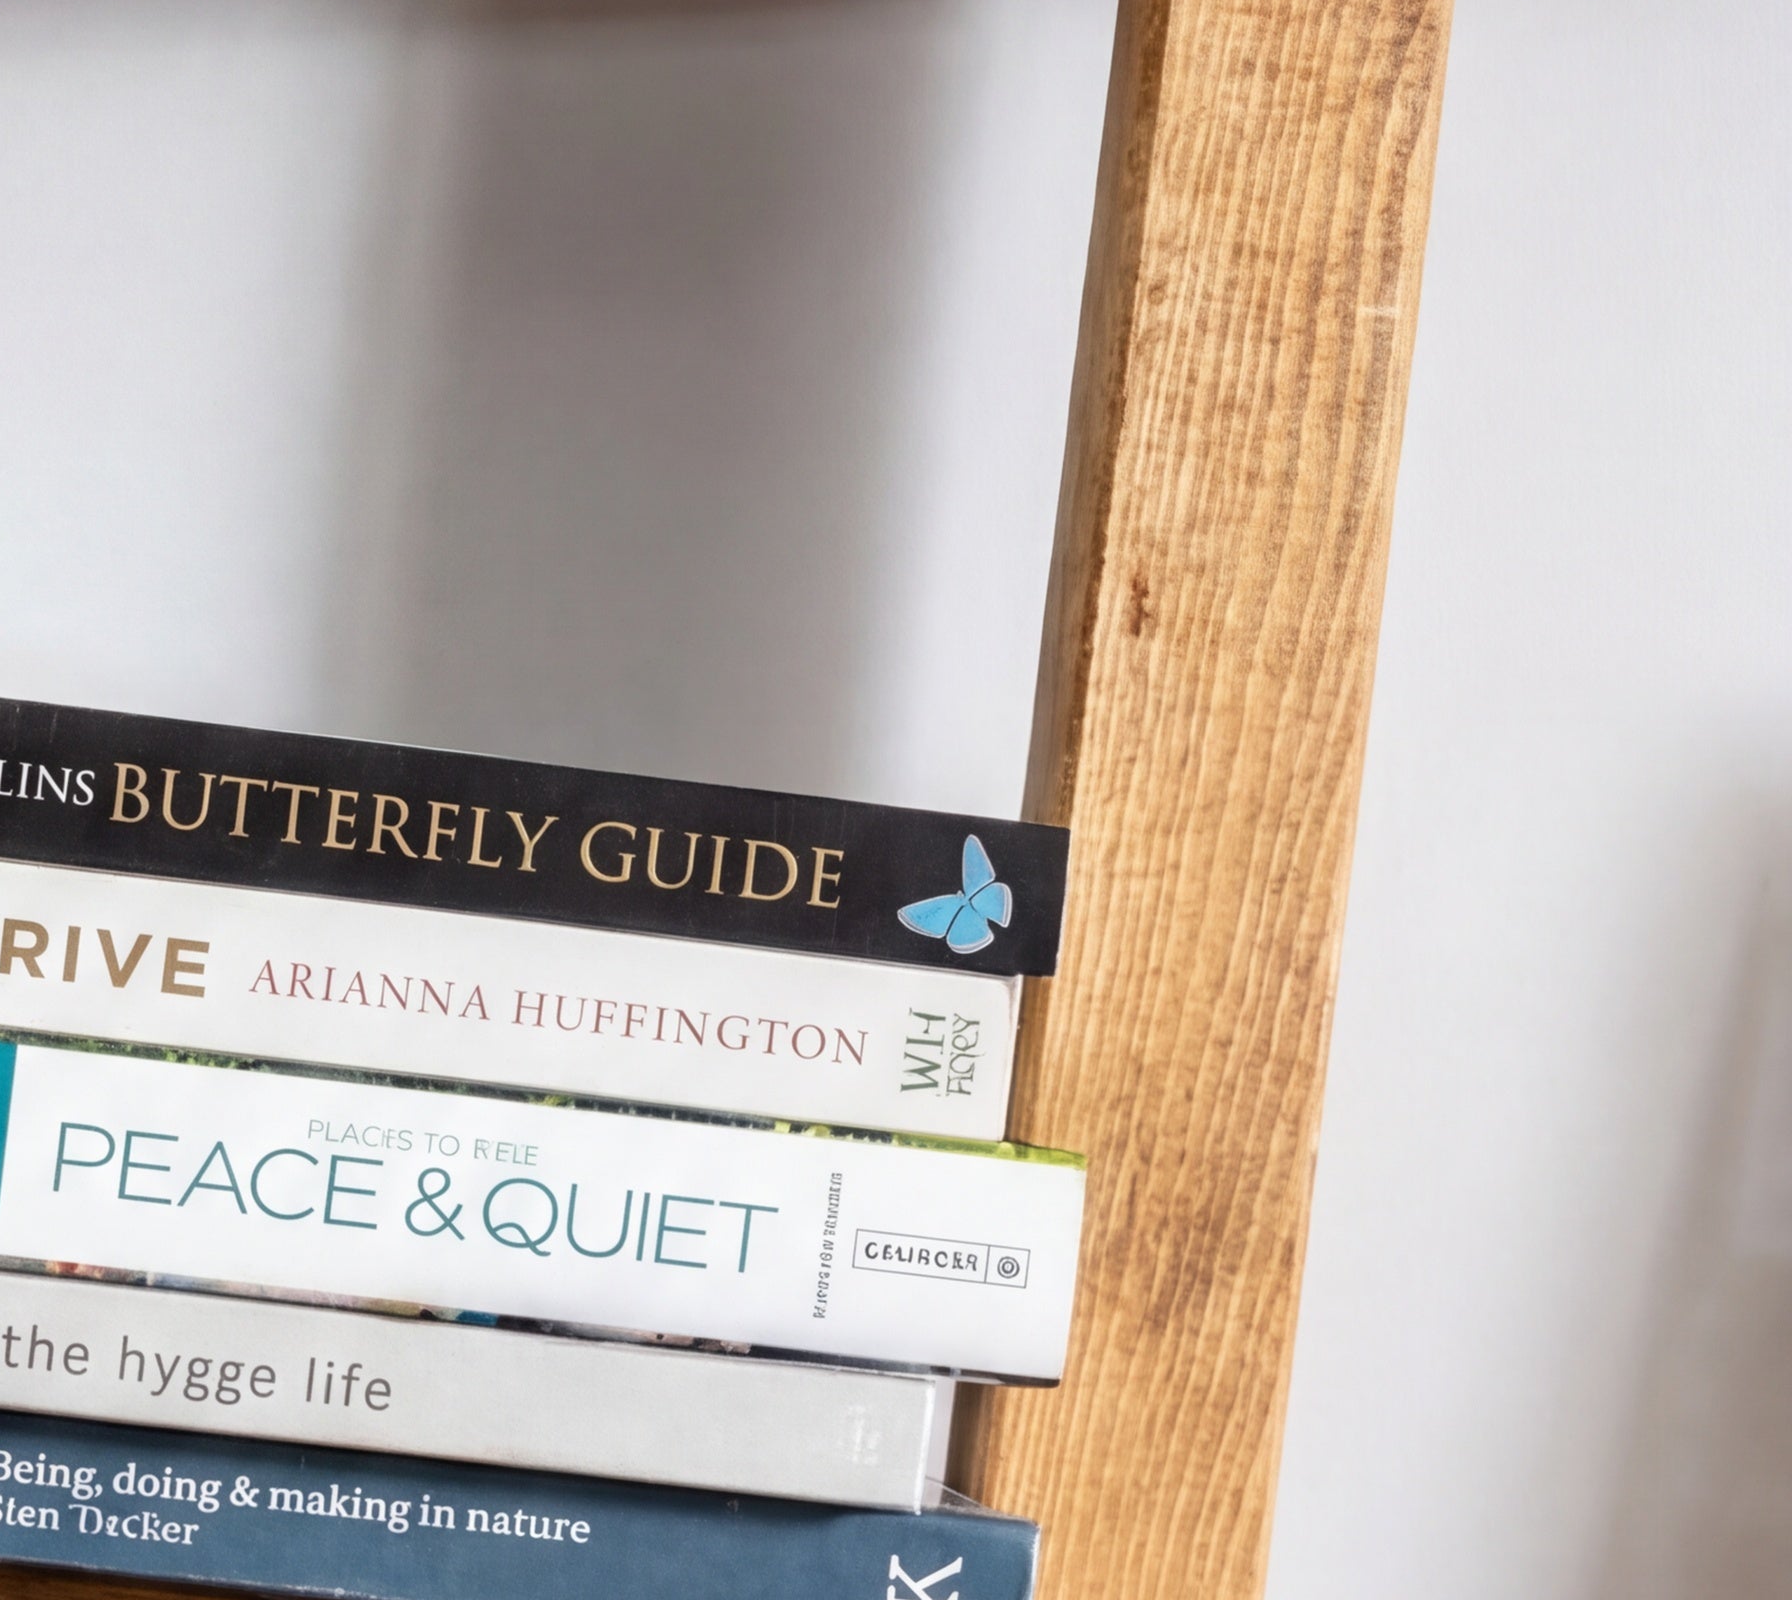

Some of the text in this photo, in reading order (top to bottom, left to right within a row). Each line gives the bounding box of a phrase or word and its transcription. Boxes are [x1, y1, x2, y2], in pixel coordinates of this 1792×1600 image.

[109, 761, 559, 873] BUTTERFLY
[580, 820, 845, 910] GUIDE
[248, 959, 490, 1021] ARIANNA
[512, 990, 870, 1066] HUFFINGTON
[425, 1131, 461, 1158] TO
[52, 1121, 385, 1230] PEACE
[404, 1167, 466, 1241] &
[481, 1177, 779, 1274] QUIET
[1, 1324, 393, 1412] the hygge life
[112, 1462, 222, 1513] doing
[229, 1475, 260, 1509] &
[268, 1484, 413, 1534] making
[418, 1494, 457, 1531] in
[466, 1503, 592, 1544] nature
